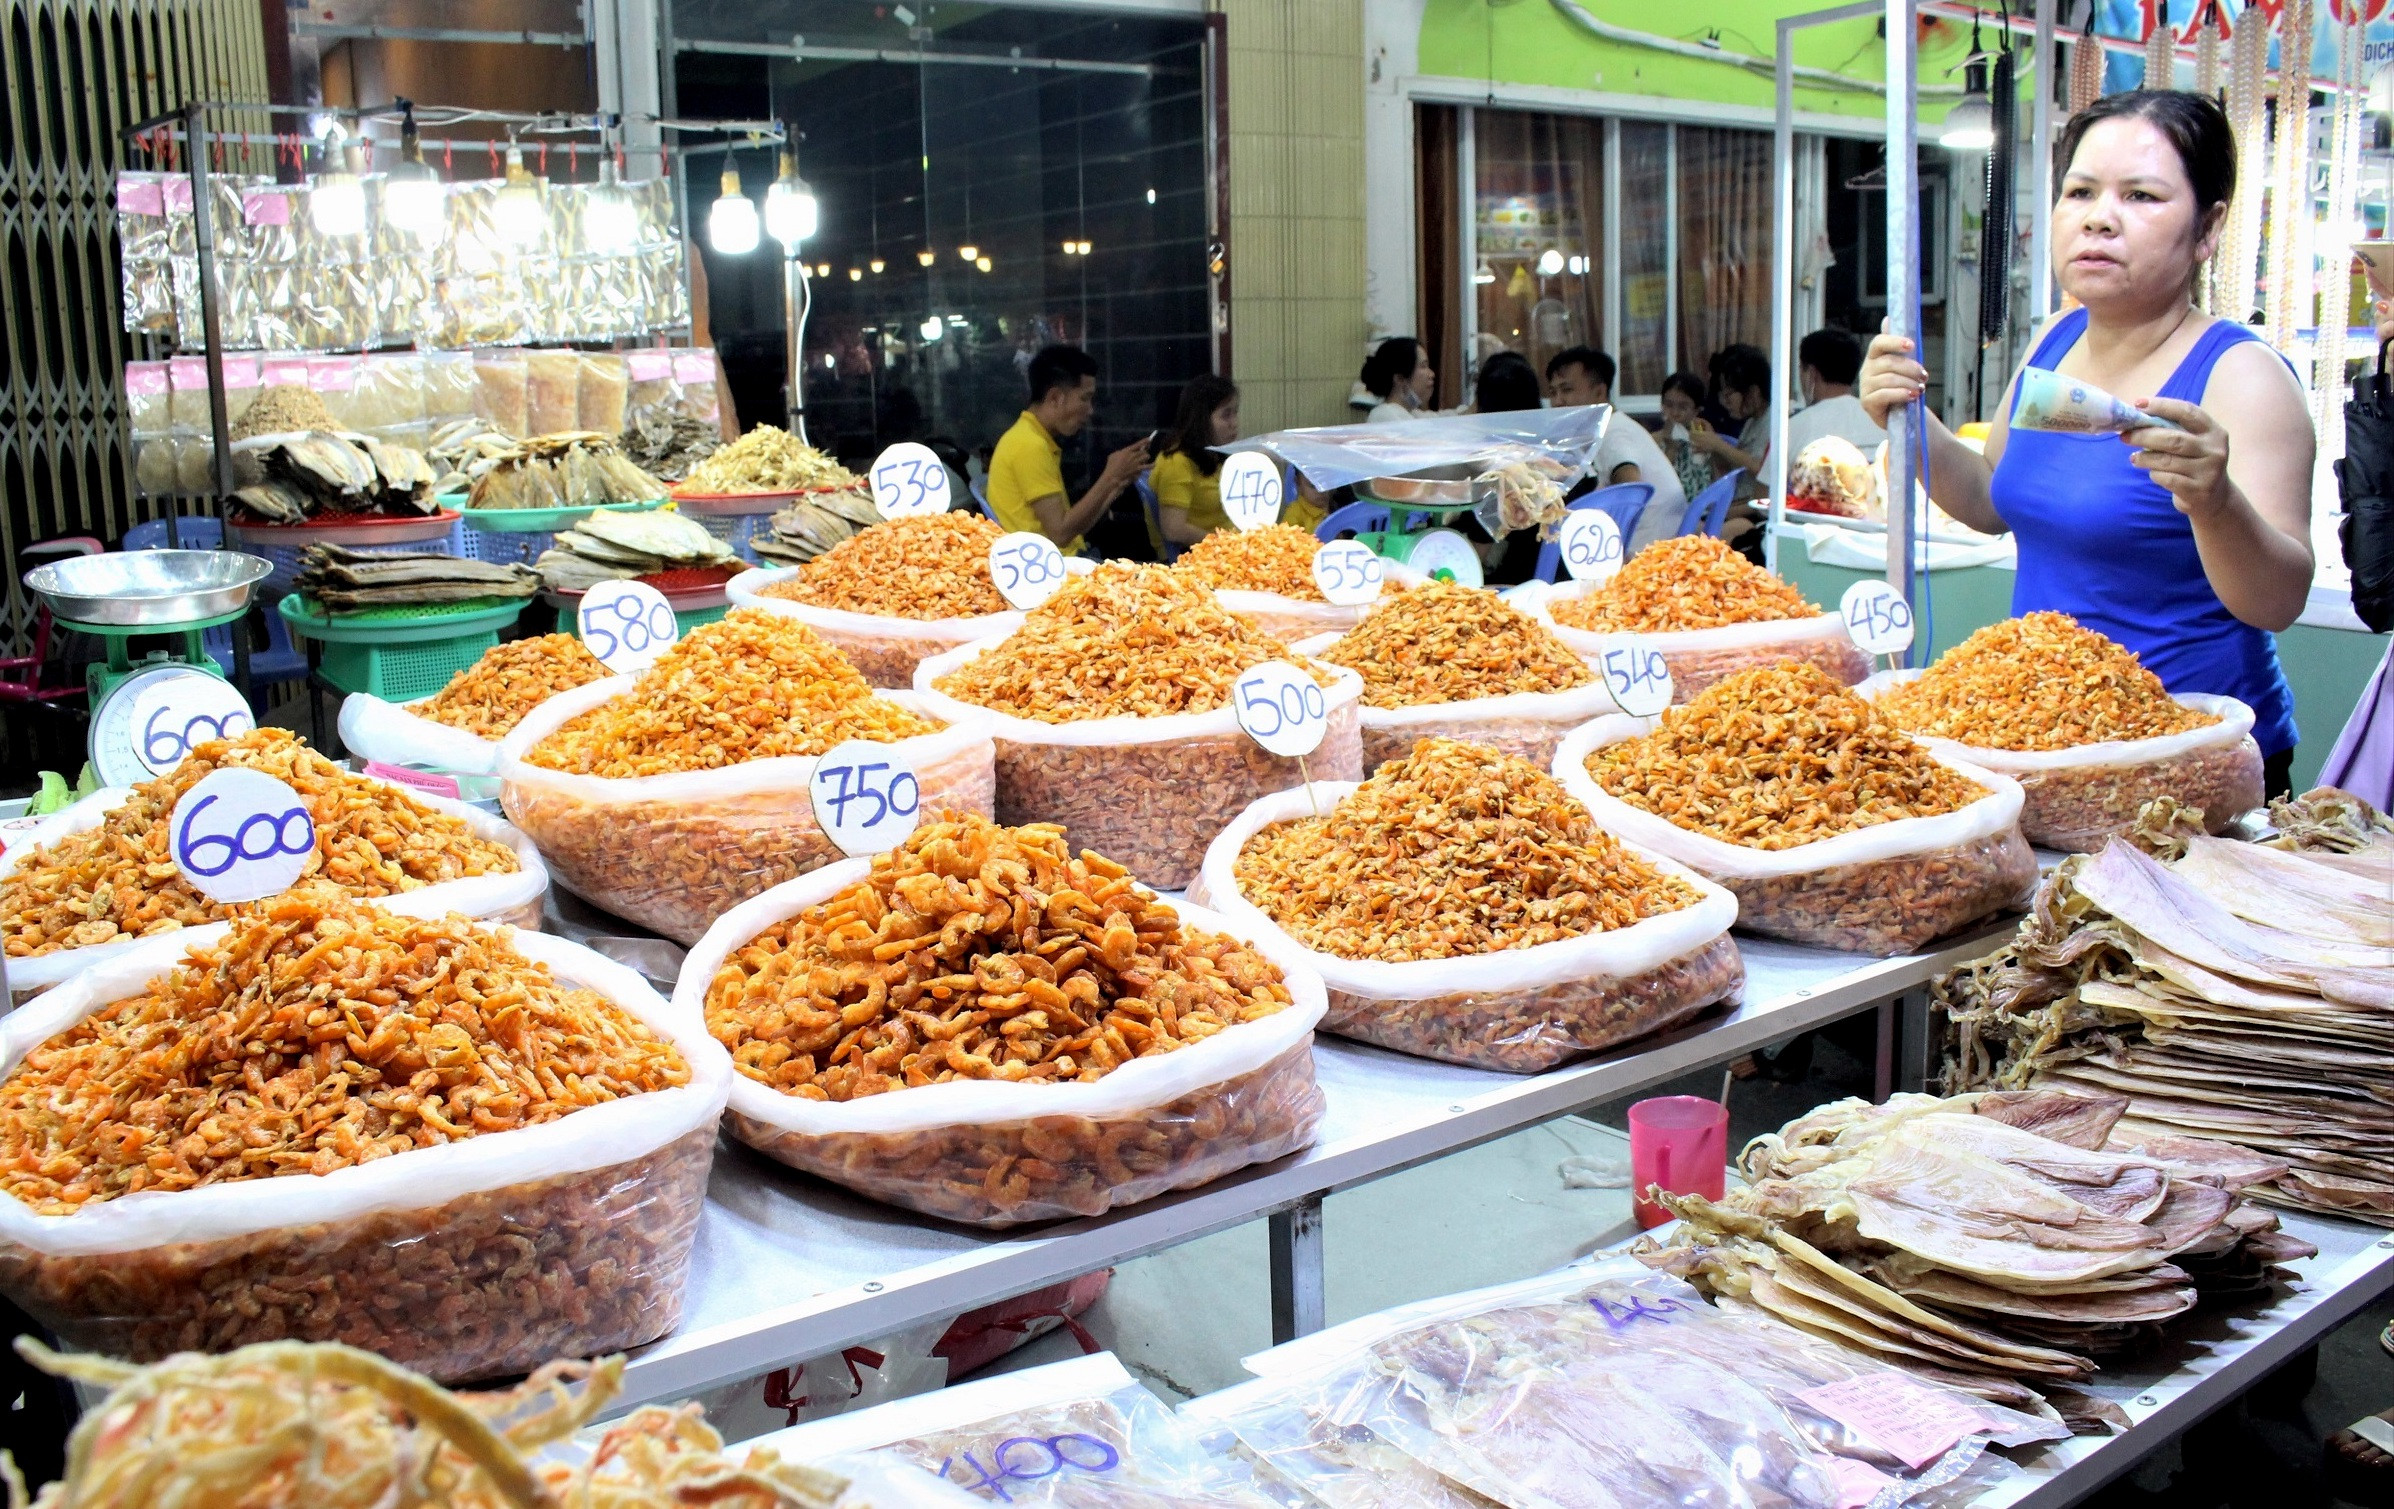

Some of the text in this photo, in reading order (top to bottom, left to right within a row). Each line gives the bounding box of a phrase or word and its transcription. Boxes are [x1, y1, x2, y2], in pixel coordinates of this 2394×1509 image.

[877, 460, 944, 507] 530
[1226, 469, 1280, 515] 470
[997, 542, 1065, 590] 580
[1568, 524, 1621, 565] 620
[1320, 550, 1382, 590] 550
[582, 595, 675, 660] 580
[1850, 593, 1910, 640] 450
[1604, 647, 1668, 694] 540
[1241, 679, 1324, 736] 500
[144, 706, 252, 765] 600
[819, 762, 919, 828] 750
[178, 795, 314, 877] 600
[938, 1433, 1119, 1504] 400
